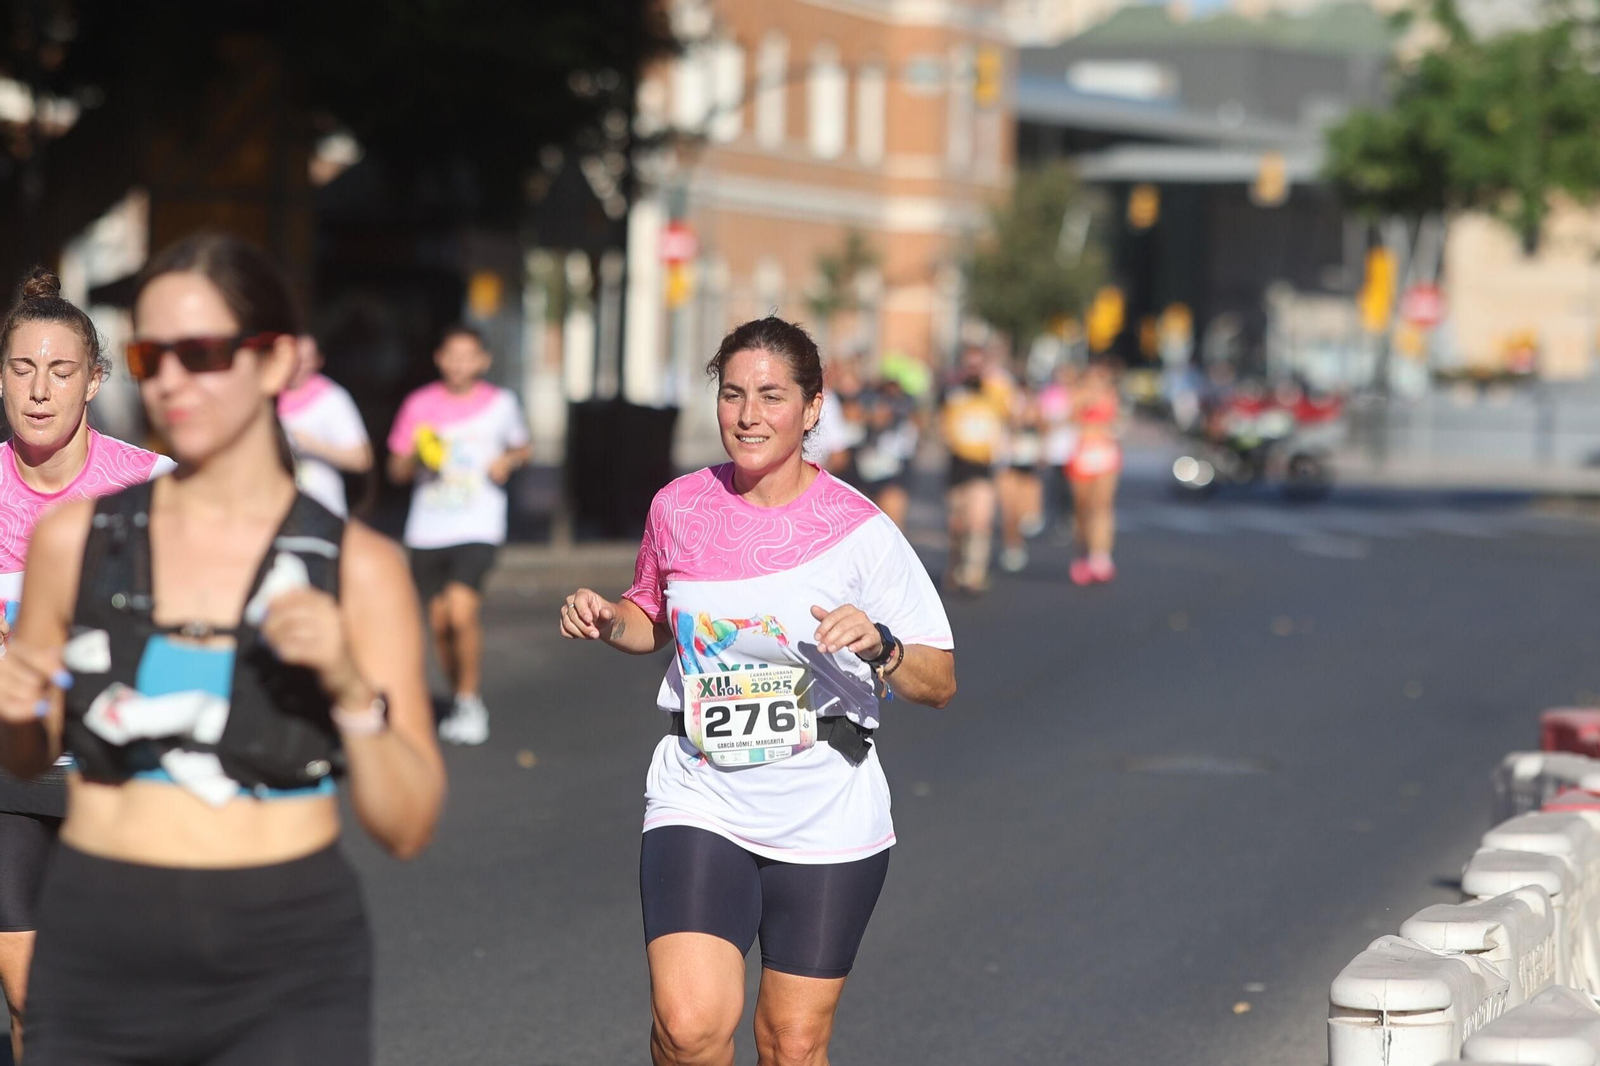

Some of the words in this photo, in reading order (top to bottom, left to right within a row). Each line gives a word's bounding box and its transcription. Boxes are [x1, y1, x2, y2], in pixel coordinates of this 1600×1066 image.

[699, 676, 730, 698] XII
[720, 684, 743, 697] 10k
[750, 679, 792, 694] 2025
[705, 701, 796, 738] 276
[717, 741, 735, 749] GARCÍA
[755, 738, 784, 746] MARGARITA
